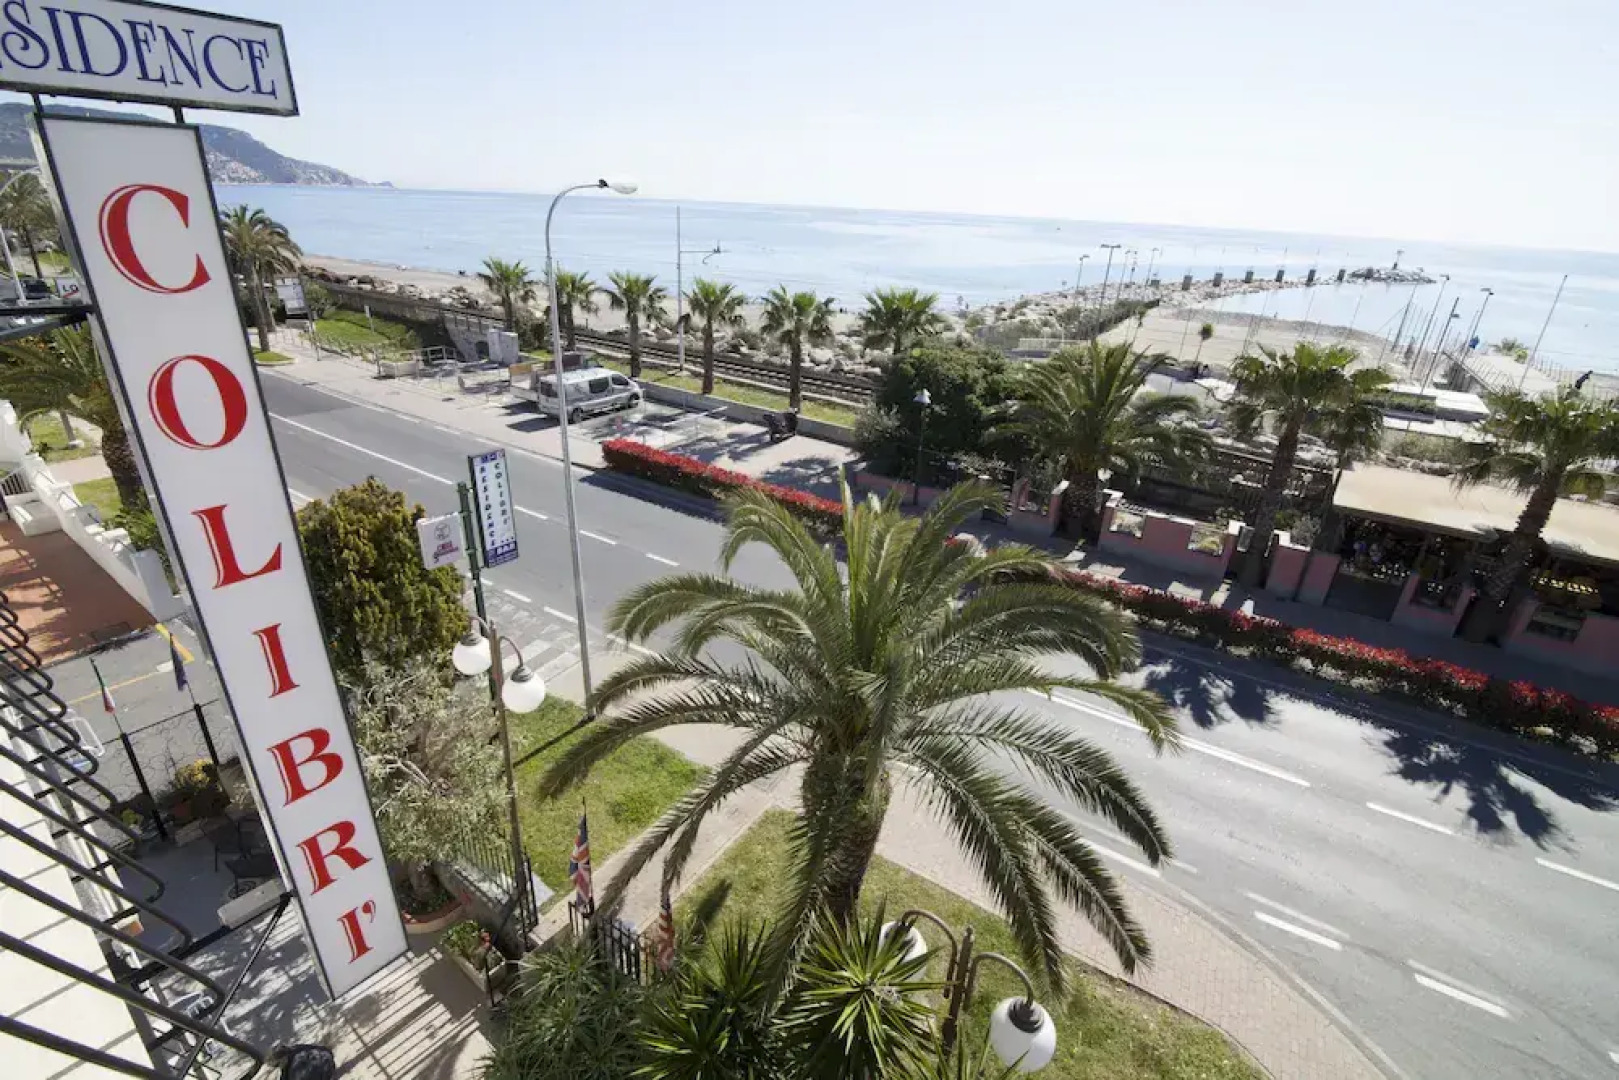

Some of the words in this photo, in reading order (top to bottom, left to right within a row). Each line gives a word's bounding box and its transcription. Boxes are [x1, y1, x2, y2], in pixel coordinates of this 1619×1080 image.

[0, 0, 278, 99] SIDENCE
[480, 465, 496, 547] RESIDENCE
[98, 184, 377, 964] COLIBRI'
